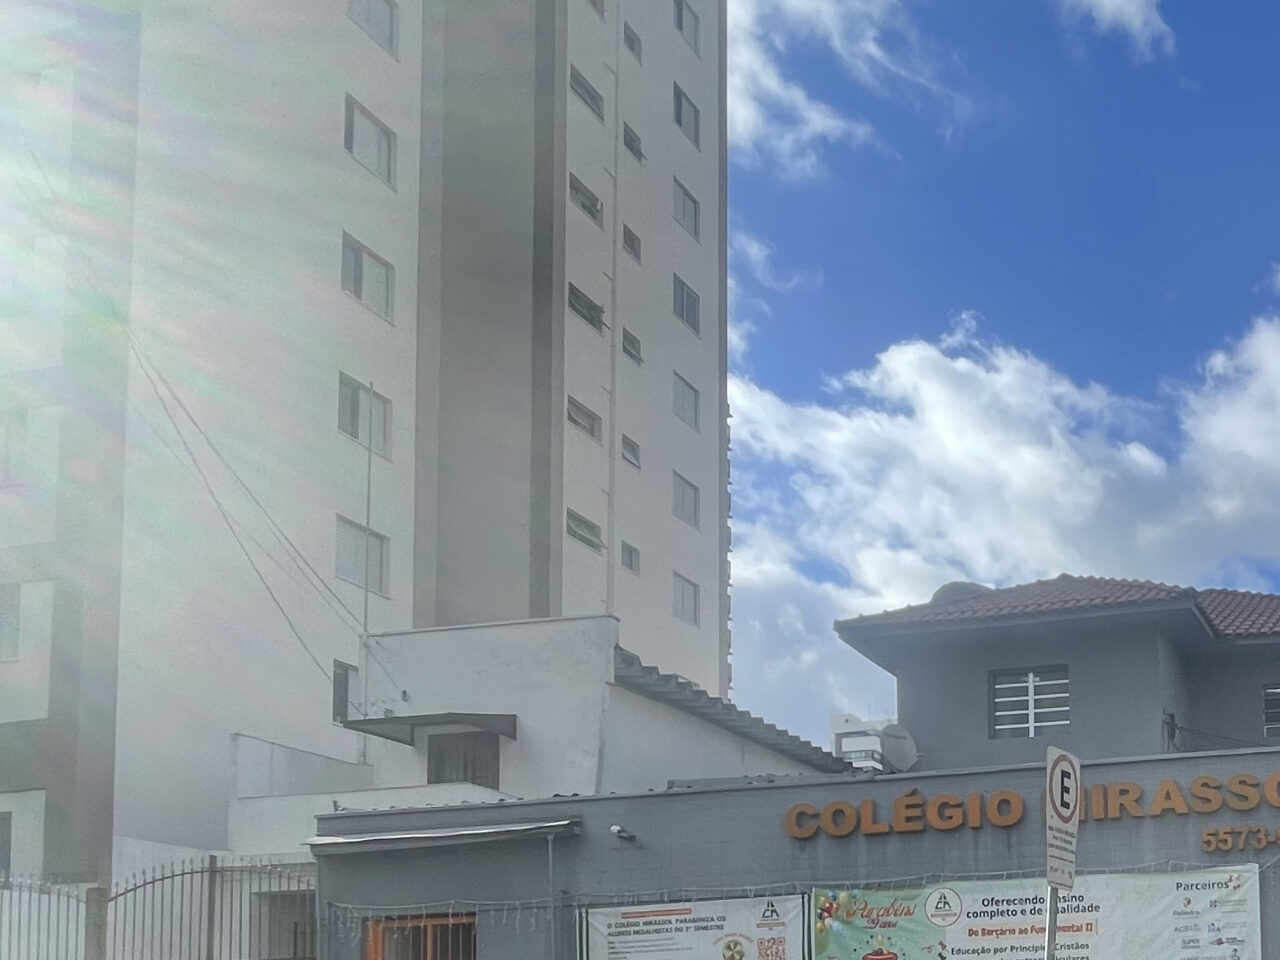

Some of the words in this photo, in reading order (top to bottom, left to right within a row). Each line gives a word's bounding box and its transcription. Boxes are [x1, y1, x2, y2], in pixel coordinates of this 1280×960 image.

[1060, 769, 1071, 810] E
[785, 788, 1024, 839] COLÉGIO
[1175, 880, 1230, 892] Parceiros
[981, 895, 1045, 908] Oferecendo
[1056, 892, 1084, 904] nsino
[966, 907, 1018, 920] completo
[1020, 908, 1027, 916] e
[1029, 906, 1043, 916] de
[951, 946, 991, 956] Educação
[993, 947, 1008, 955] por
